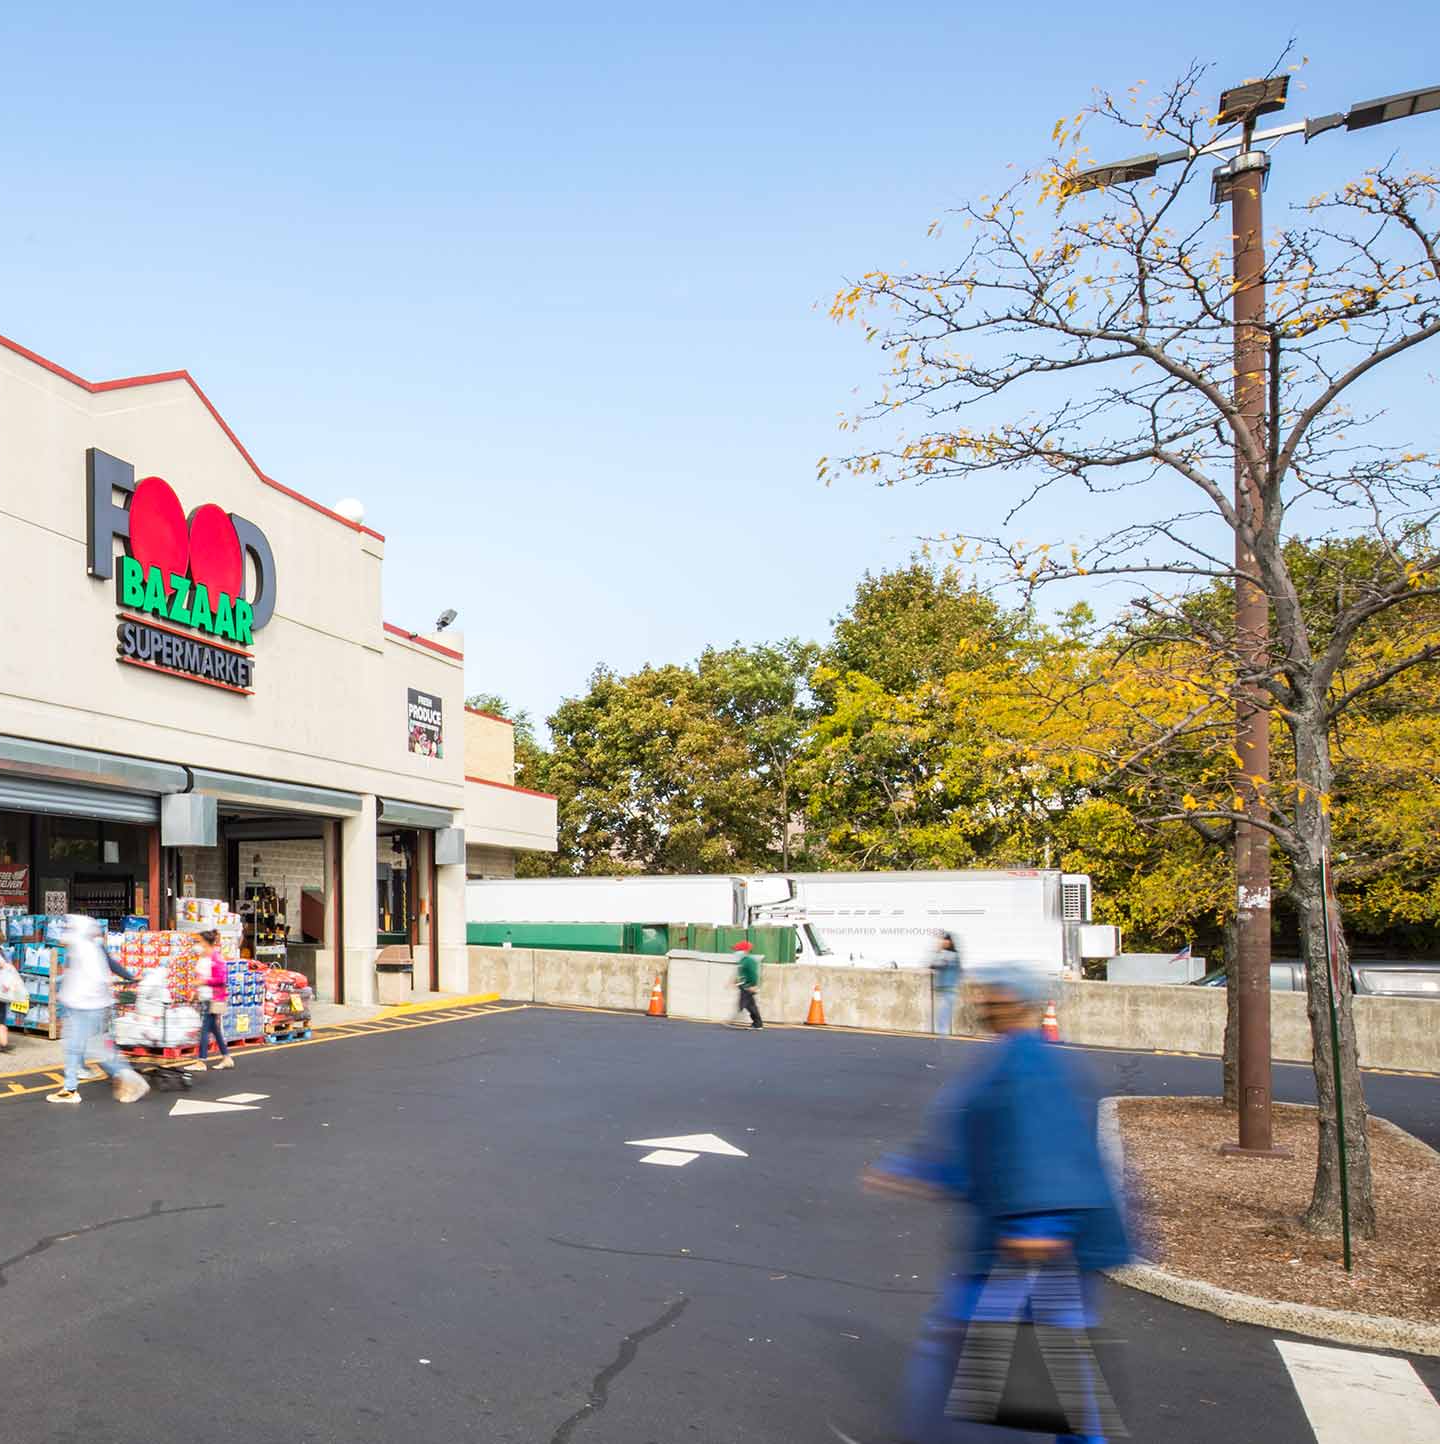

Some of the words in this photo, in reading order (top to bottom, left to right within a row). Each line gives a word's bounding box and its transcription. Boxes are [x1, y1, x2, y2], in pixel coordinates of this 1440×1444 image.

[86, 447, 277, 631] FOOD
[116, 555, 254, 645] BAZAAR
[117, 623, 256, 688] SUPERMARKET
[408, 703, 442, 726] PRODUCE
[878, 927, 945, 937] WAREHOUSES
